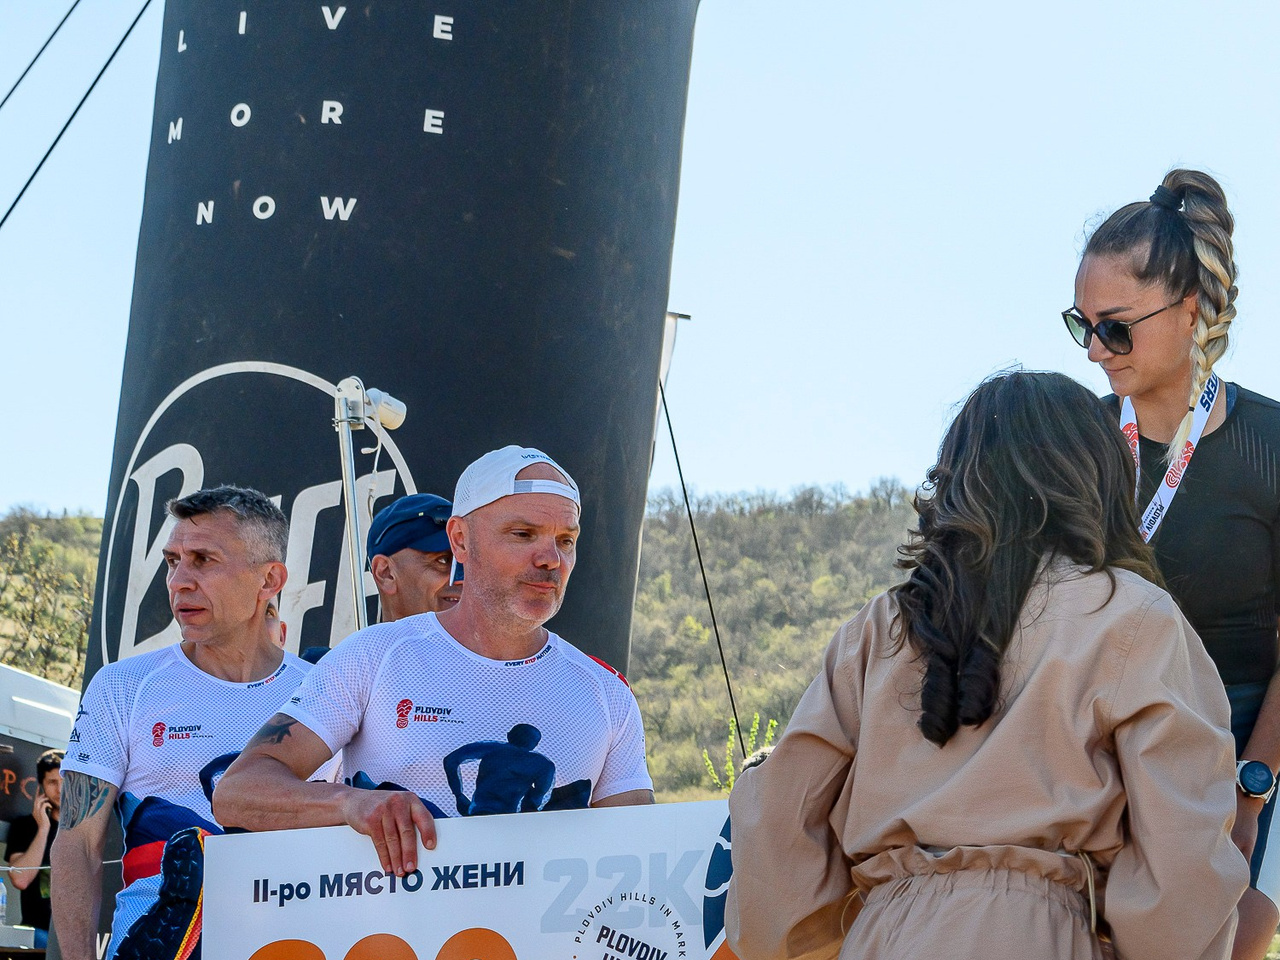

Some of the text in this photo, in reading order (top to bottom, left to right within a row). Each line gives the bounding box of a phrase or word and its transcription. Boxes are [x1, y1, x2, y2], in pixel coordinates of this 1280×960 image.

[177, 6, 455, 52] LIVE
[167, 100, 446, 144] MORE
[195, 195, 358, 225] NOW
[1200, 372, 1218, 412] TERS
[1147, 503, 1165, 532] PLOVDIV
[413, 714, 439, 723] HILLS
[414, 705, 452, 716] PLOVDIV
[168, 724, 202, 733] PLOVDIV
[319, 867, 424, 899] МЯСТО
[430, 860, 525, 891] ЖЕНИ
[574, 895, 614, 944] PLOVDIV
[620, 892, 656, 906] HILLS
[659, 903, 672, 918] IN
